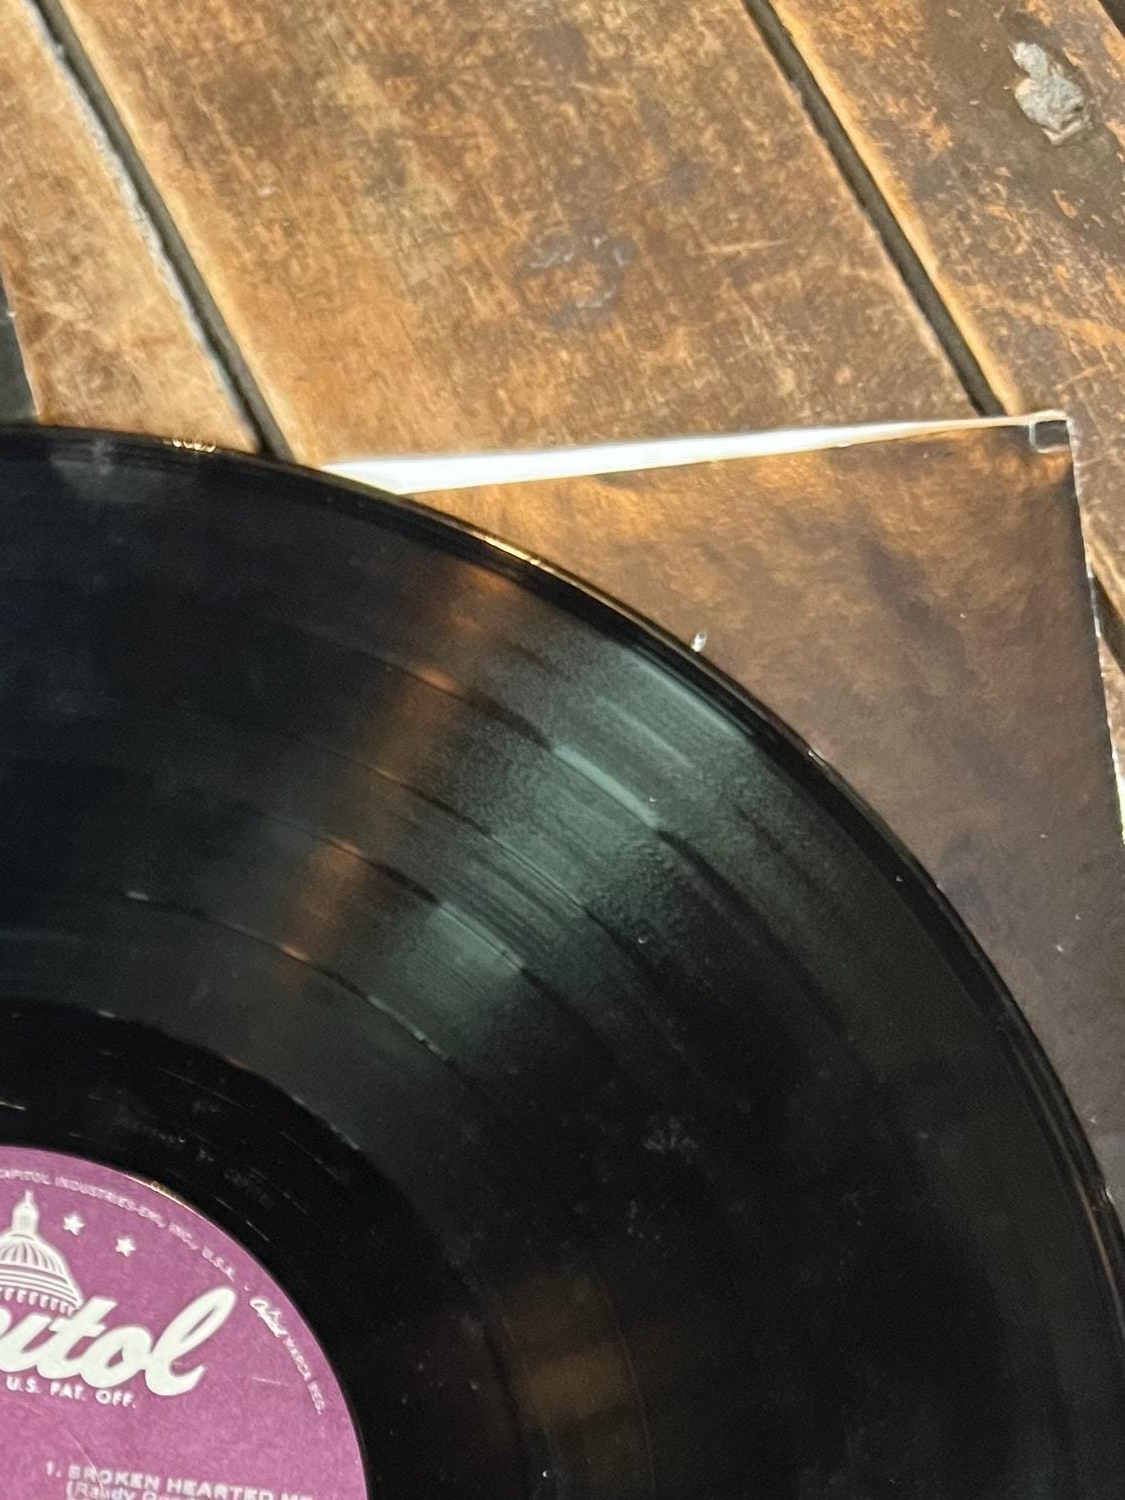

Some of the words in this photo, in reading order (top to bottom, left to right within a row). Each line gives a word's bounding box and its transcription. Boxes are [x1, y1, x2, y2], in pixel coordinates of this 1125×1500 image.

[6, 1376, 42, 1394] U.S.
[95, 1389, 138, 1408] OFF.
[46, 1461, 62, 1478] 1.
[67, 1464, 160, 1492] BROKEN
